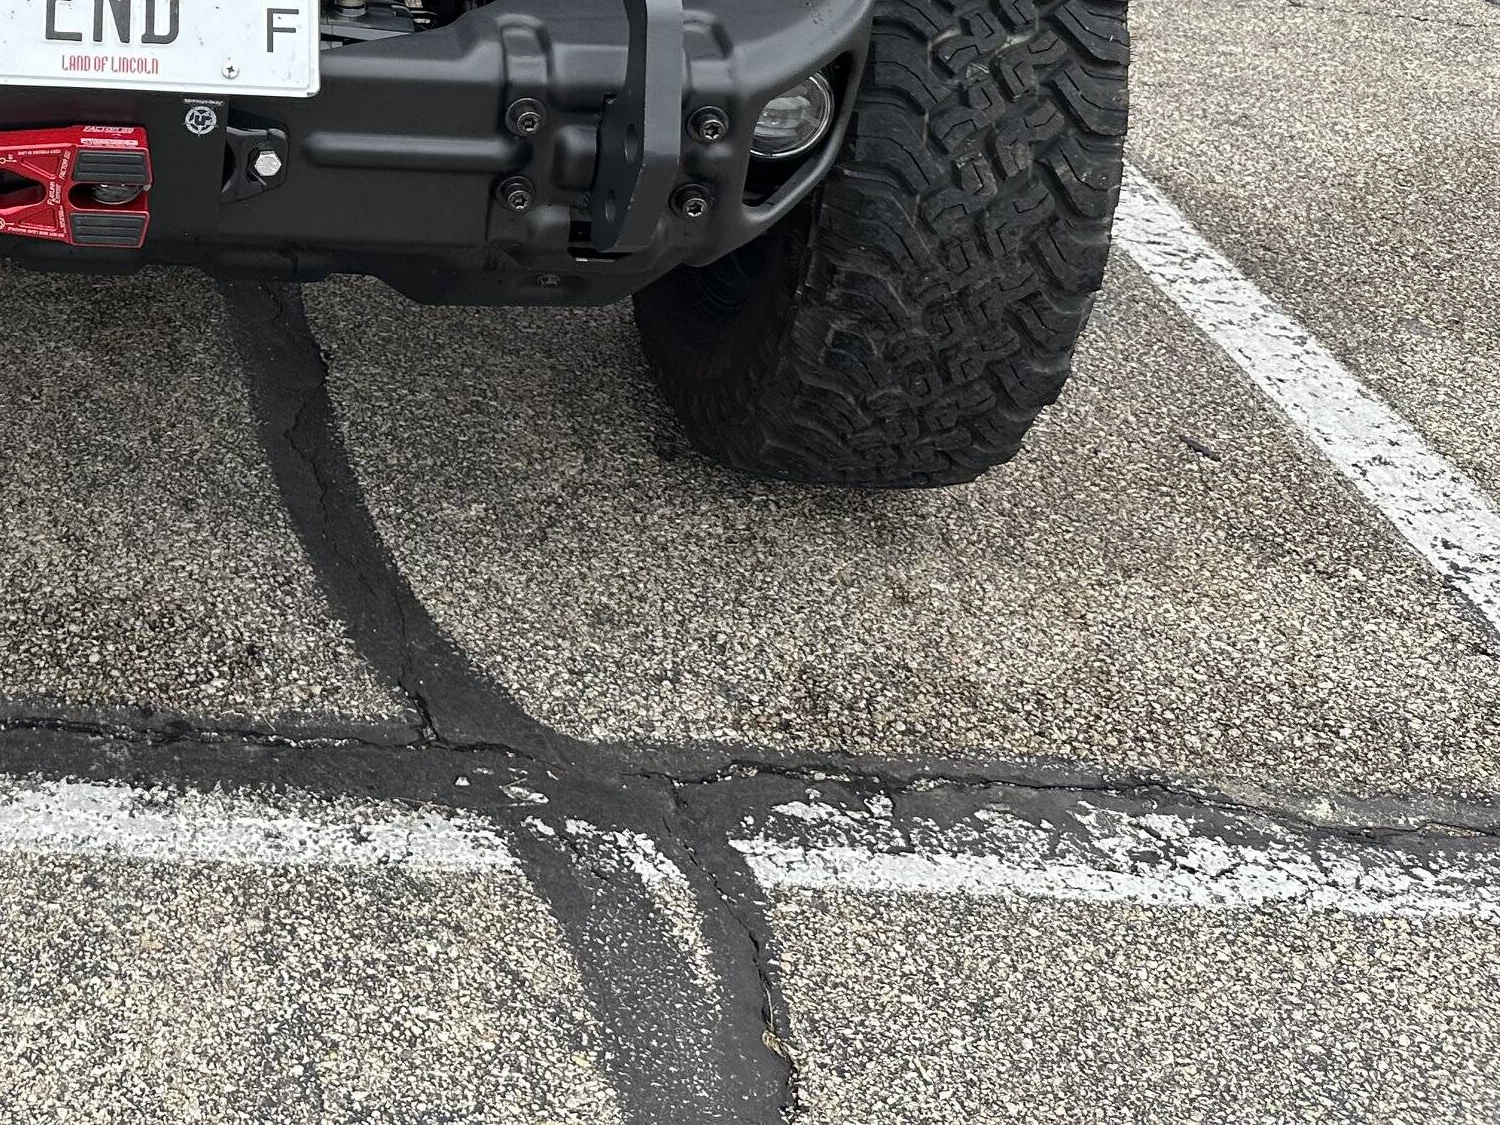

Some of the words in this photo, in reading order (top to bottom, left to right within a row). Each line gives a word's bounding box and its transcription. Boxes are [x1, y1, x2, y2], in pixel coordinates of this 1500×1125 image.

[61, 54, 92, 72] LAND
[93, 56, 109, 73] OF
[110, 56, 160, 75] LINCOLN
